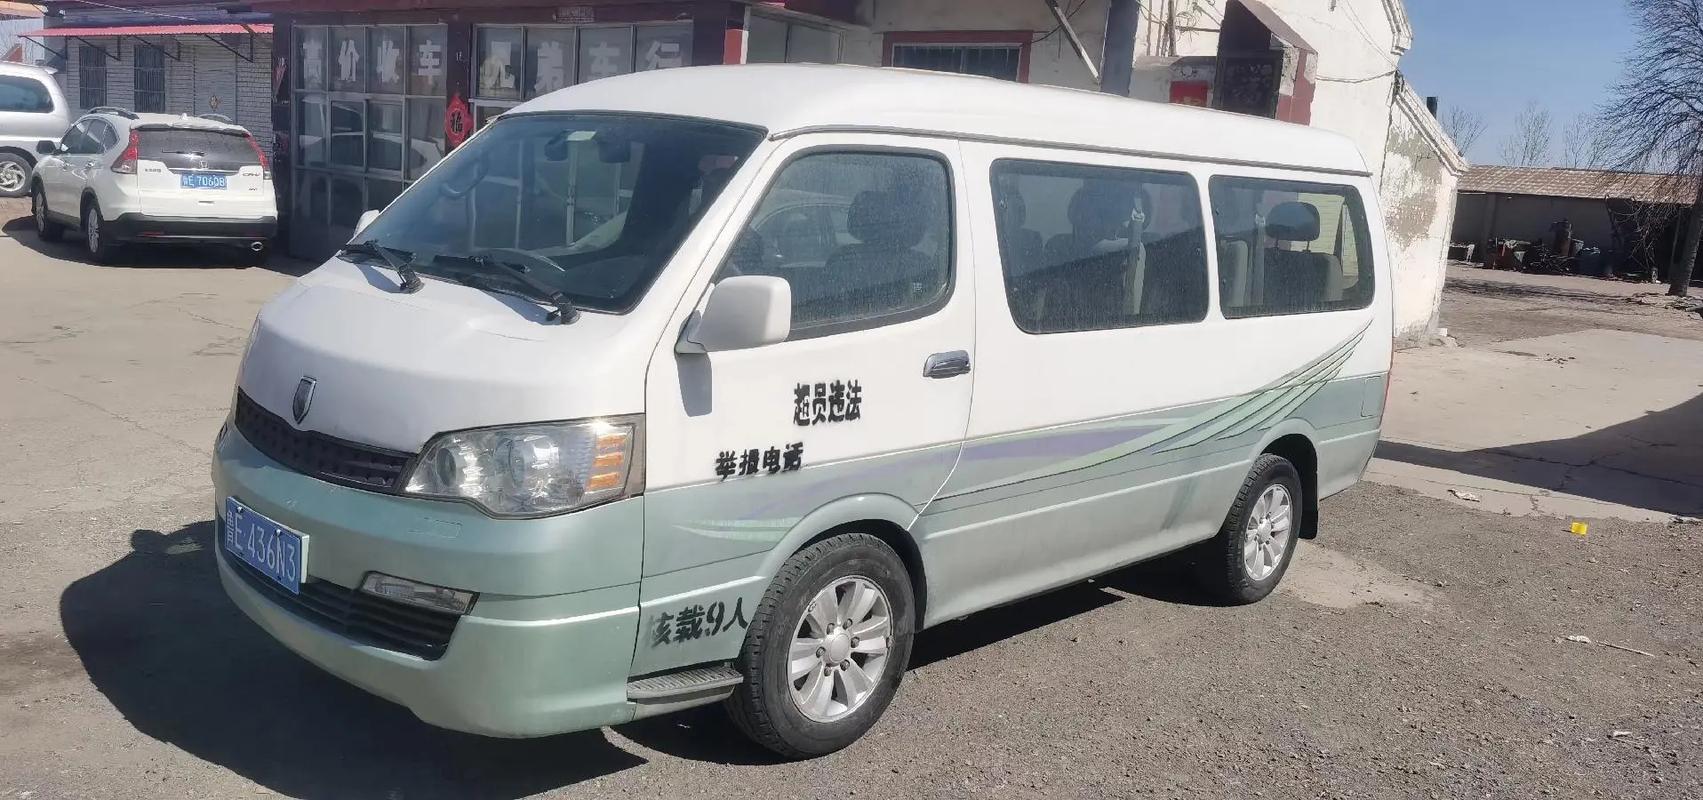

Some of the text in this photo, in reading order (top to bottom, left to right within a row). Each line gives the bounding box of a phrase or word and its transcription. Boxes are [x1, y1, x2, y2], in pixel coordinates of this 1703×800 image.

[793, 379, 862, 427] 超员违法
[715, 442, 804, 482] 举报电话
[645, 596, 749, 648] 核载9人
